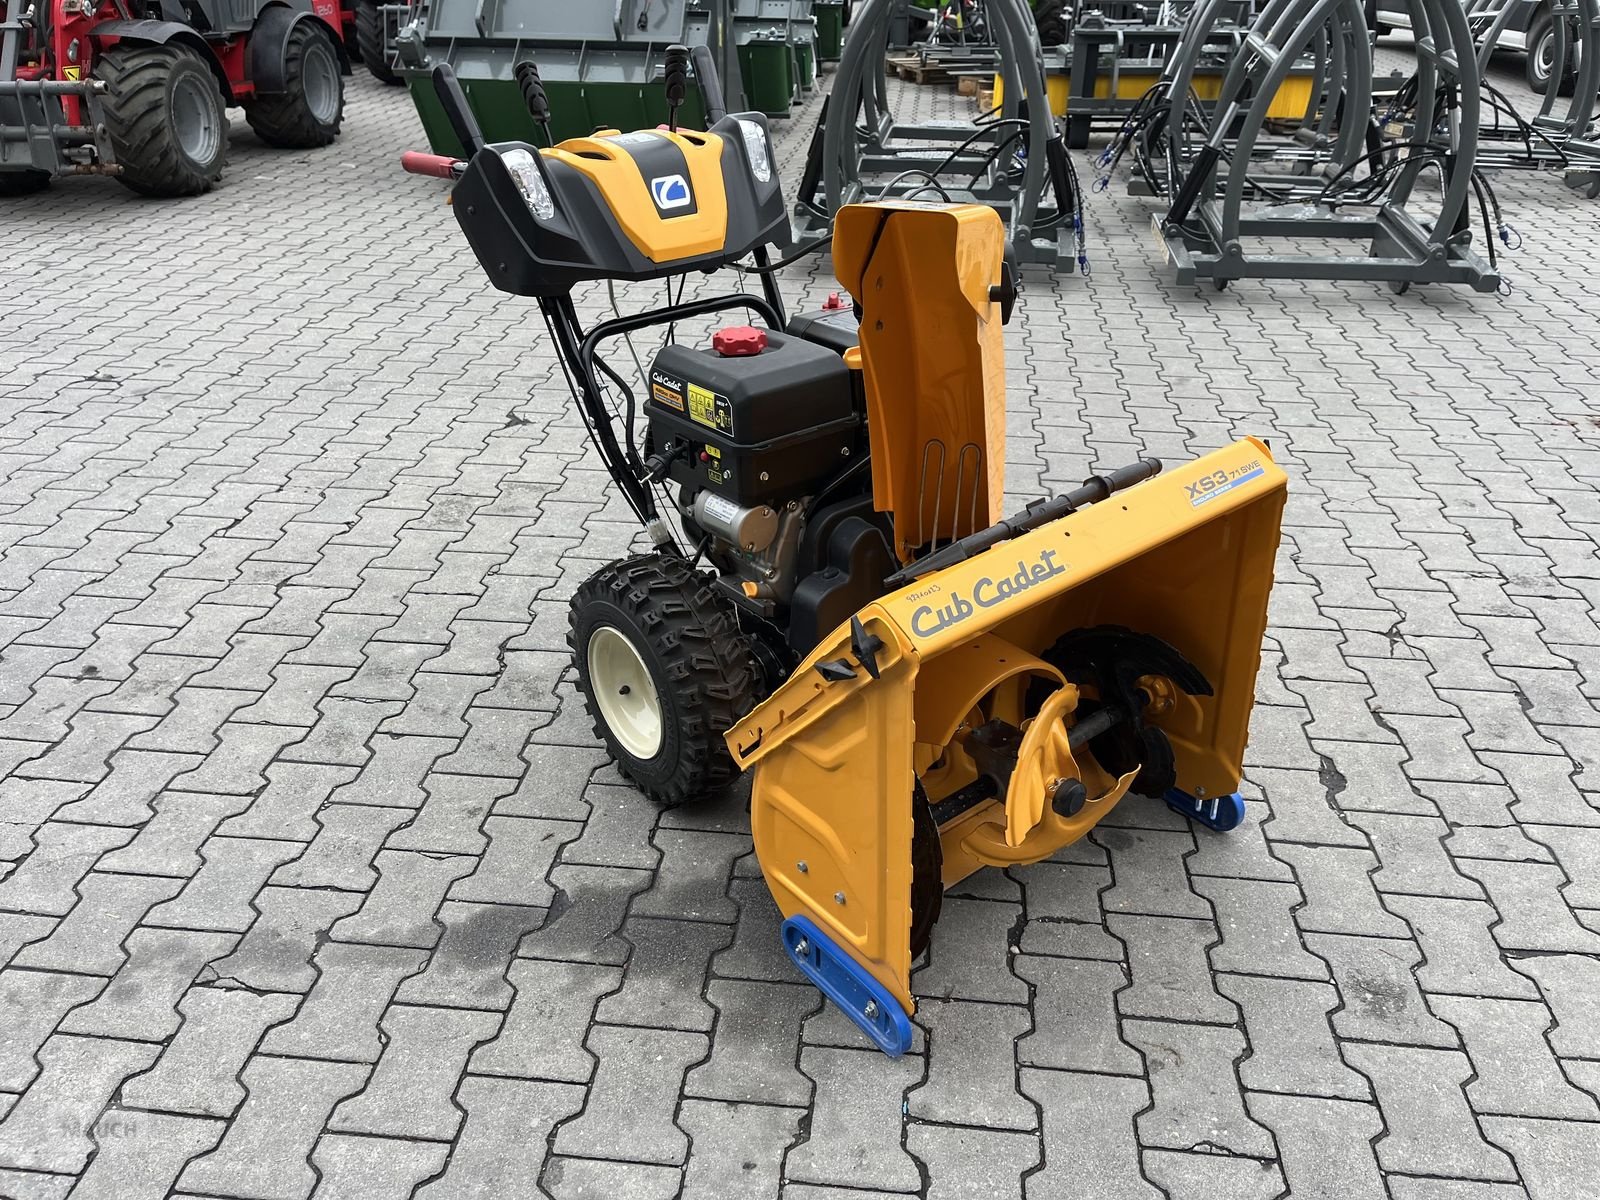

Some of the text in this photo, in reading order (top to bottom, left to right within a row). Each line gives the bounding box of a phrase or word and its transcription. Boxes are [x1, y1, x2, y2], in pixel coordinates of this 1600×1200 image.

[652, 372, 682, 391] Cub Cadet
[1183, 470, 1229, 499] XS3
[911, 549, 1066, 638] Cub Cadet
